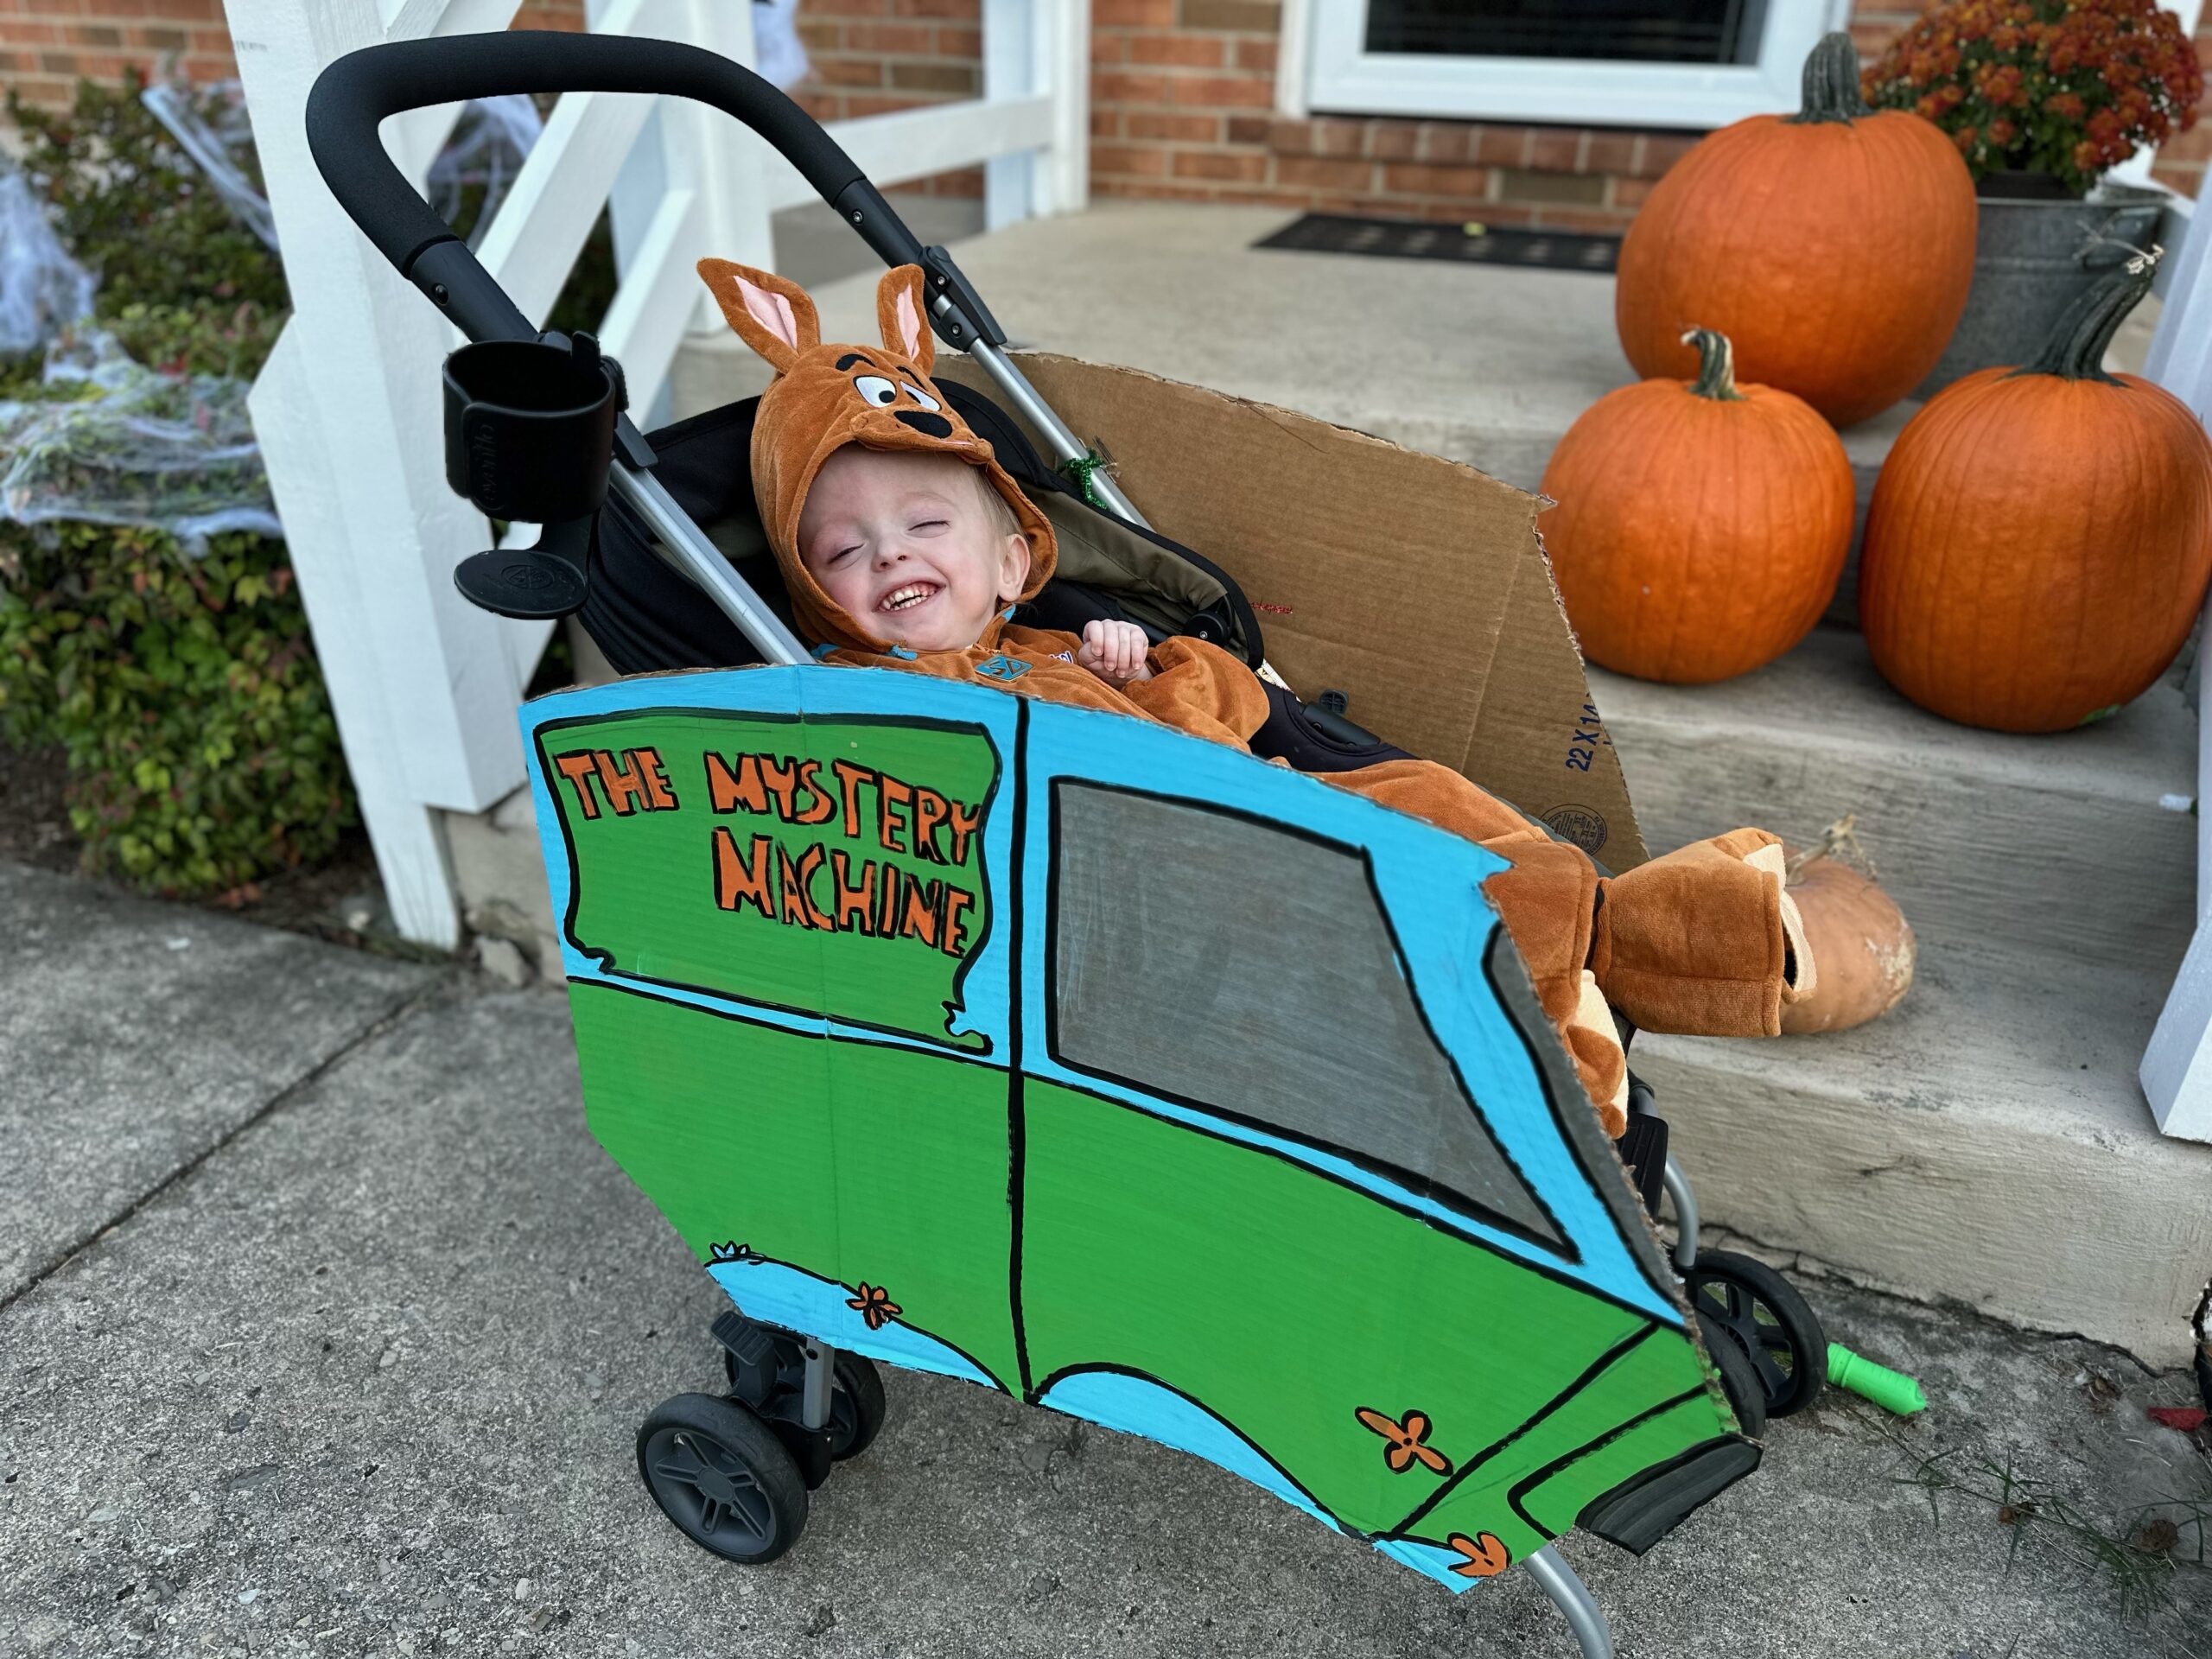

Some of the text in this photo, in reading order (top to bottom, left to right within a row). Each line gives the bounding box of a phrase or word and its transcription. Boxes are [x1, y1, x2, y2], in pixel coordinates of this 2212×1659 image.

[552, 746, 984, 867] THE MYSTERY
[1565, 747, 1594, 772] 22
[710, 826, 976, 958] MACHINE
